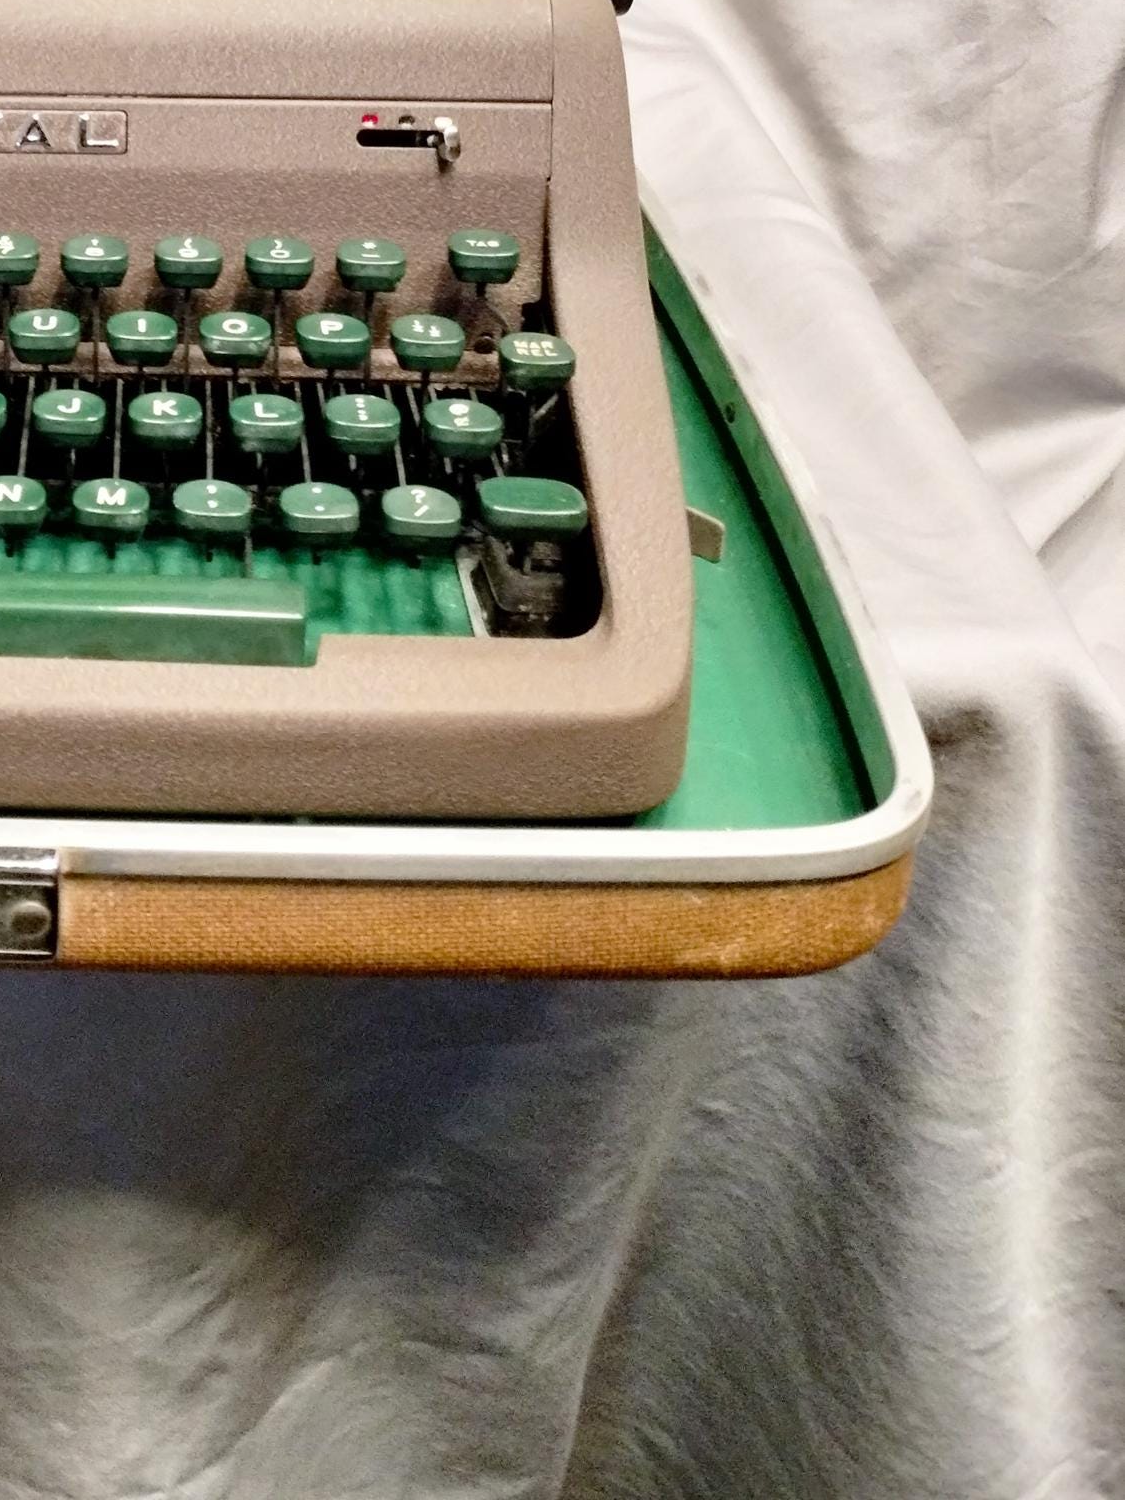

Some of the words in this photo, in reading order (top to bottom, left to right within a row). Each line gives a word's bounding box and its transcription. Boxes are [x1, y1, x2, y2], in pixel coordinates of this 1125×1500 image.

[32, 315, 58, 331] U
[222, 318, 248, 335] O
[319, 318, 344, 336] P
[56, 396, 82, 414] J
[152, 398, 178, 416] K
[253, 401, 279, 419] L
[96, 486, 127, 506] M
[410, 488, 427, 504] ?
